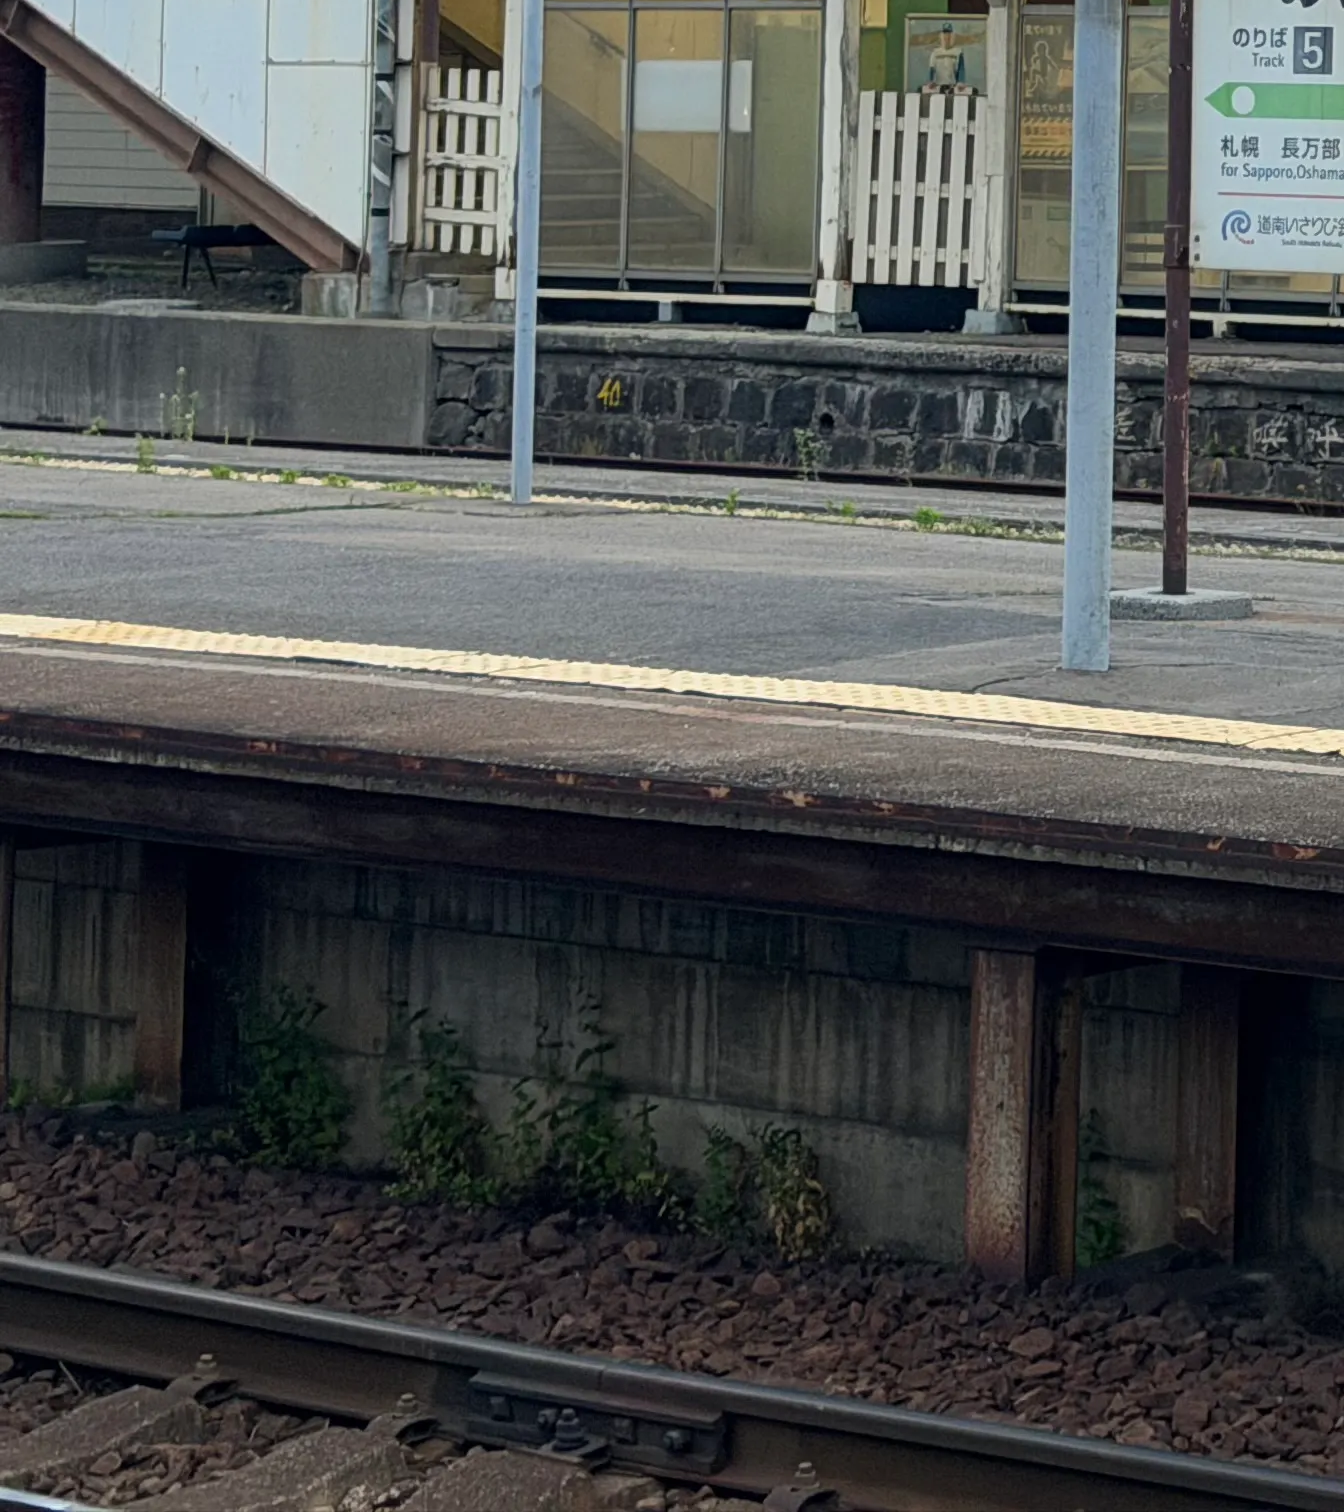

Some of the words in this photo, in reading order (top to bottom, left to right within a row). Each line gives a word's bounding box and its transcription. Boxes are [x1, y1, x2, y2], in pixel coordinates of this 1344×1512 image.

[1232, 27, 1289, 49] のりば
[1301, 31, 1324, 69] 5
[1251, 52, 1285, 68] Track
[1220, 135, 1260, 159] 札幌
[1281, 137, 1341, 161] 長万部
[1220, 161, 1239, 177] for
